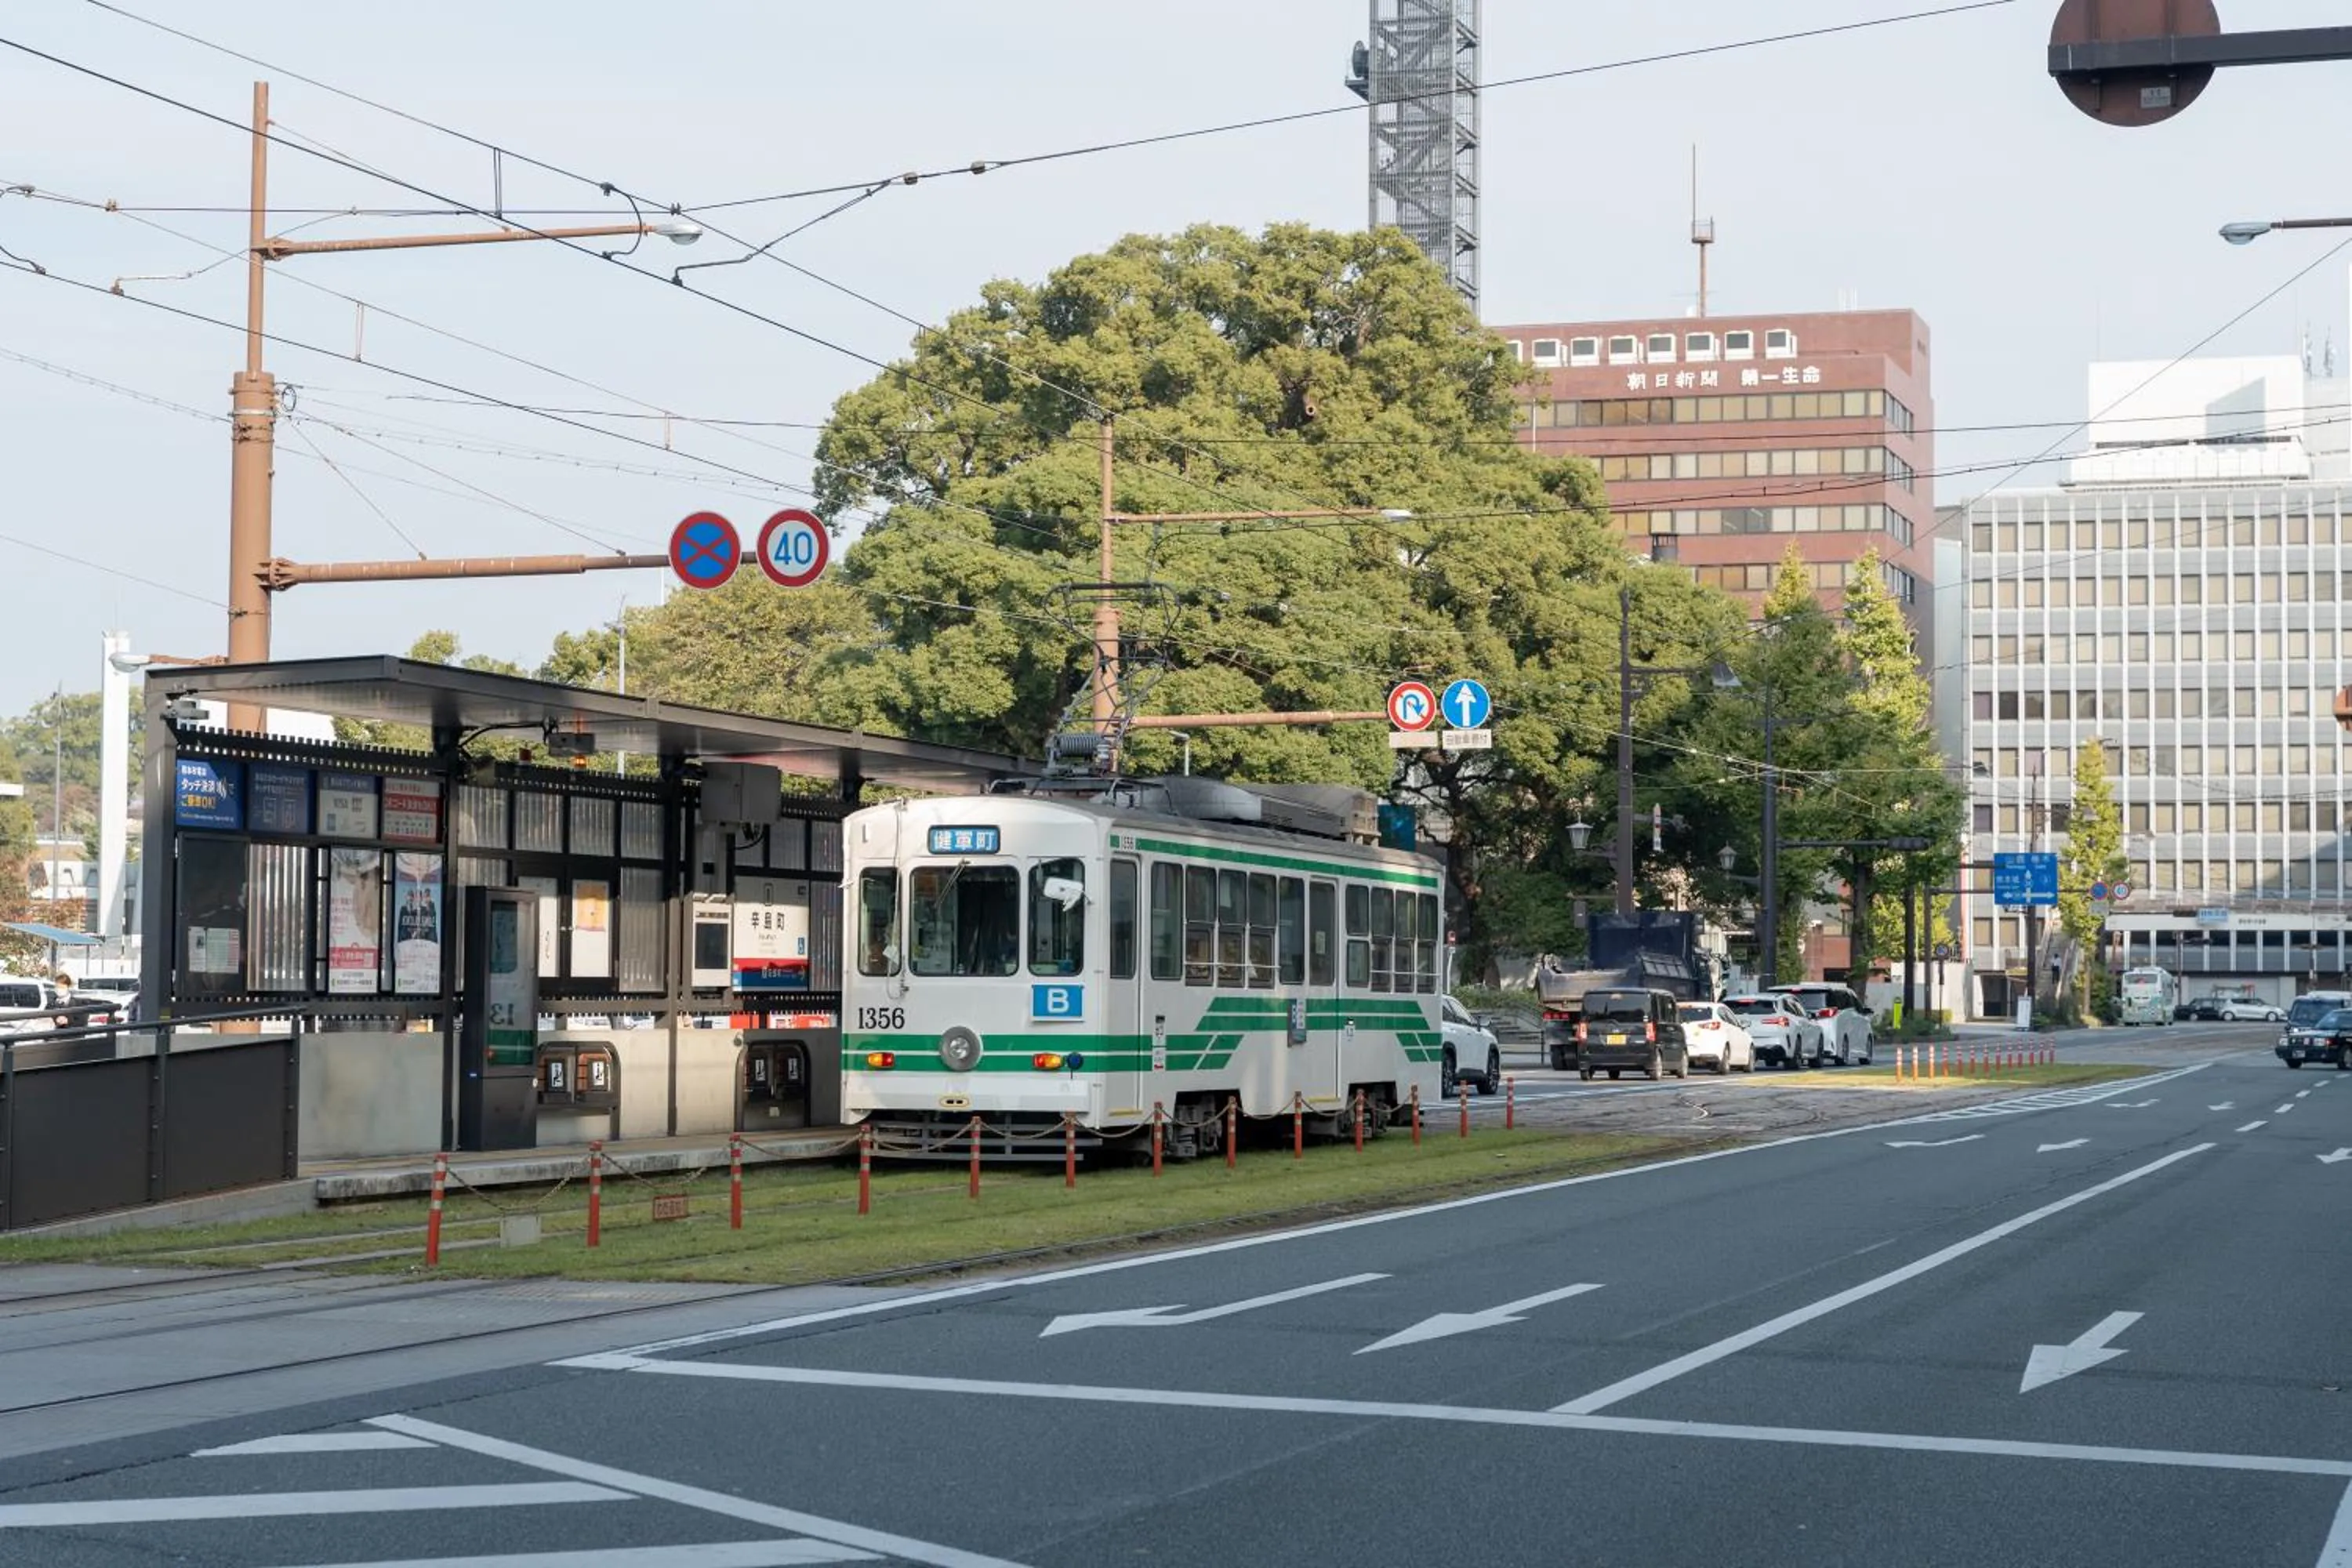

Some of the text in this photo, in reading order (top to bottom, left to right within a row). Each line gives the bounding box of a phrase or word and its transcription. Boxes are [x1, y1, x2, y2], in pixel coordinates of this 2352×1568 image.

[1627, 365, 1820, 390] 朝日新聞 第一生命
[774, 531, 813, 565] 40
[934, 830, 995, 851] 健軍町
[1047, 989, 1069, 1013] B
[858, 1007, 906, 1029] 1356
